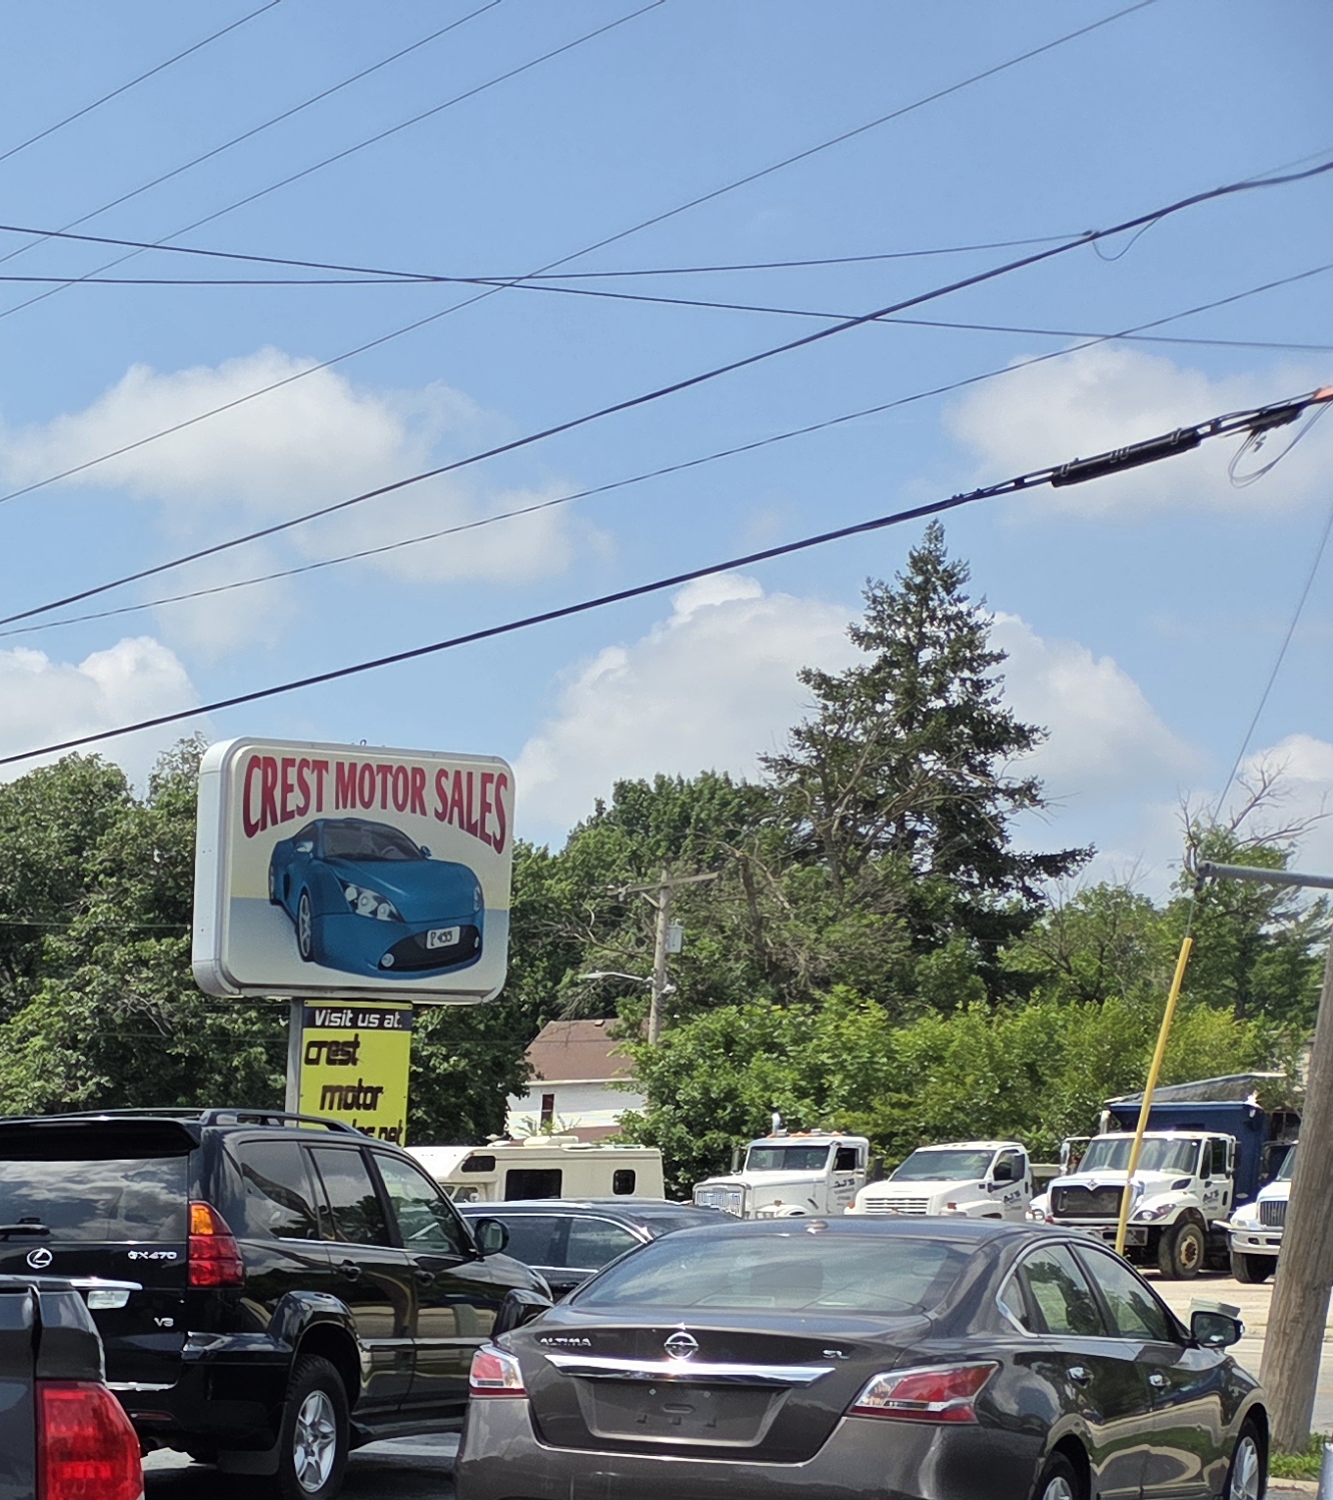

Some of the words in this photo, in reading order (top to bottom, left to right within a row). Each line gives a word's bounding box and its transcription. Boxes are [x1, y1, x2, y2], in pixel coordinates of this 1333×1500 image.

[243, 755, 329, 839] CREST
[335, 761, 428, 816] MOTOR
[434, 768, 508, 854] SALES
[315, 1009, 353, 1027] Visit
[357, 1013, 380, 1028] us
[304, 1033, 360, 1066] crest
[319, 1078, 384, 1111] motor
